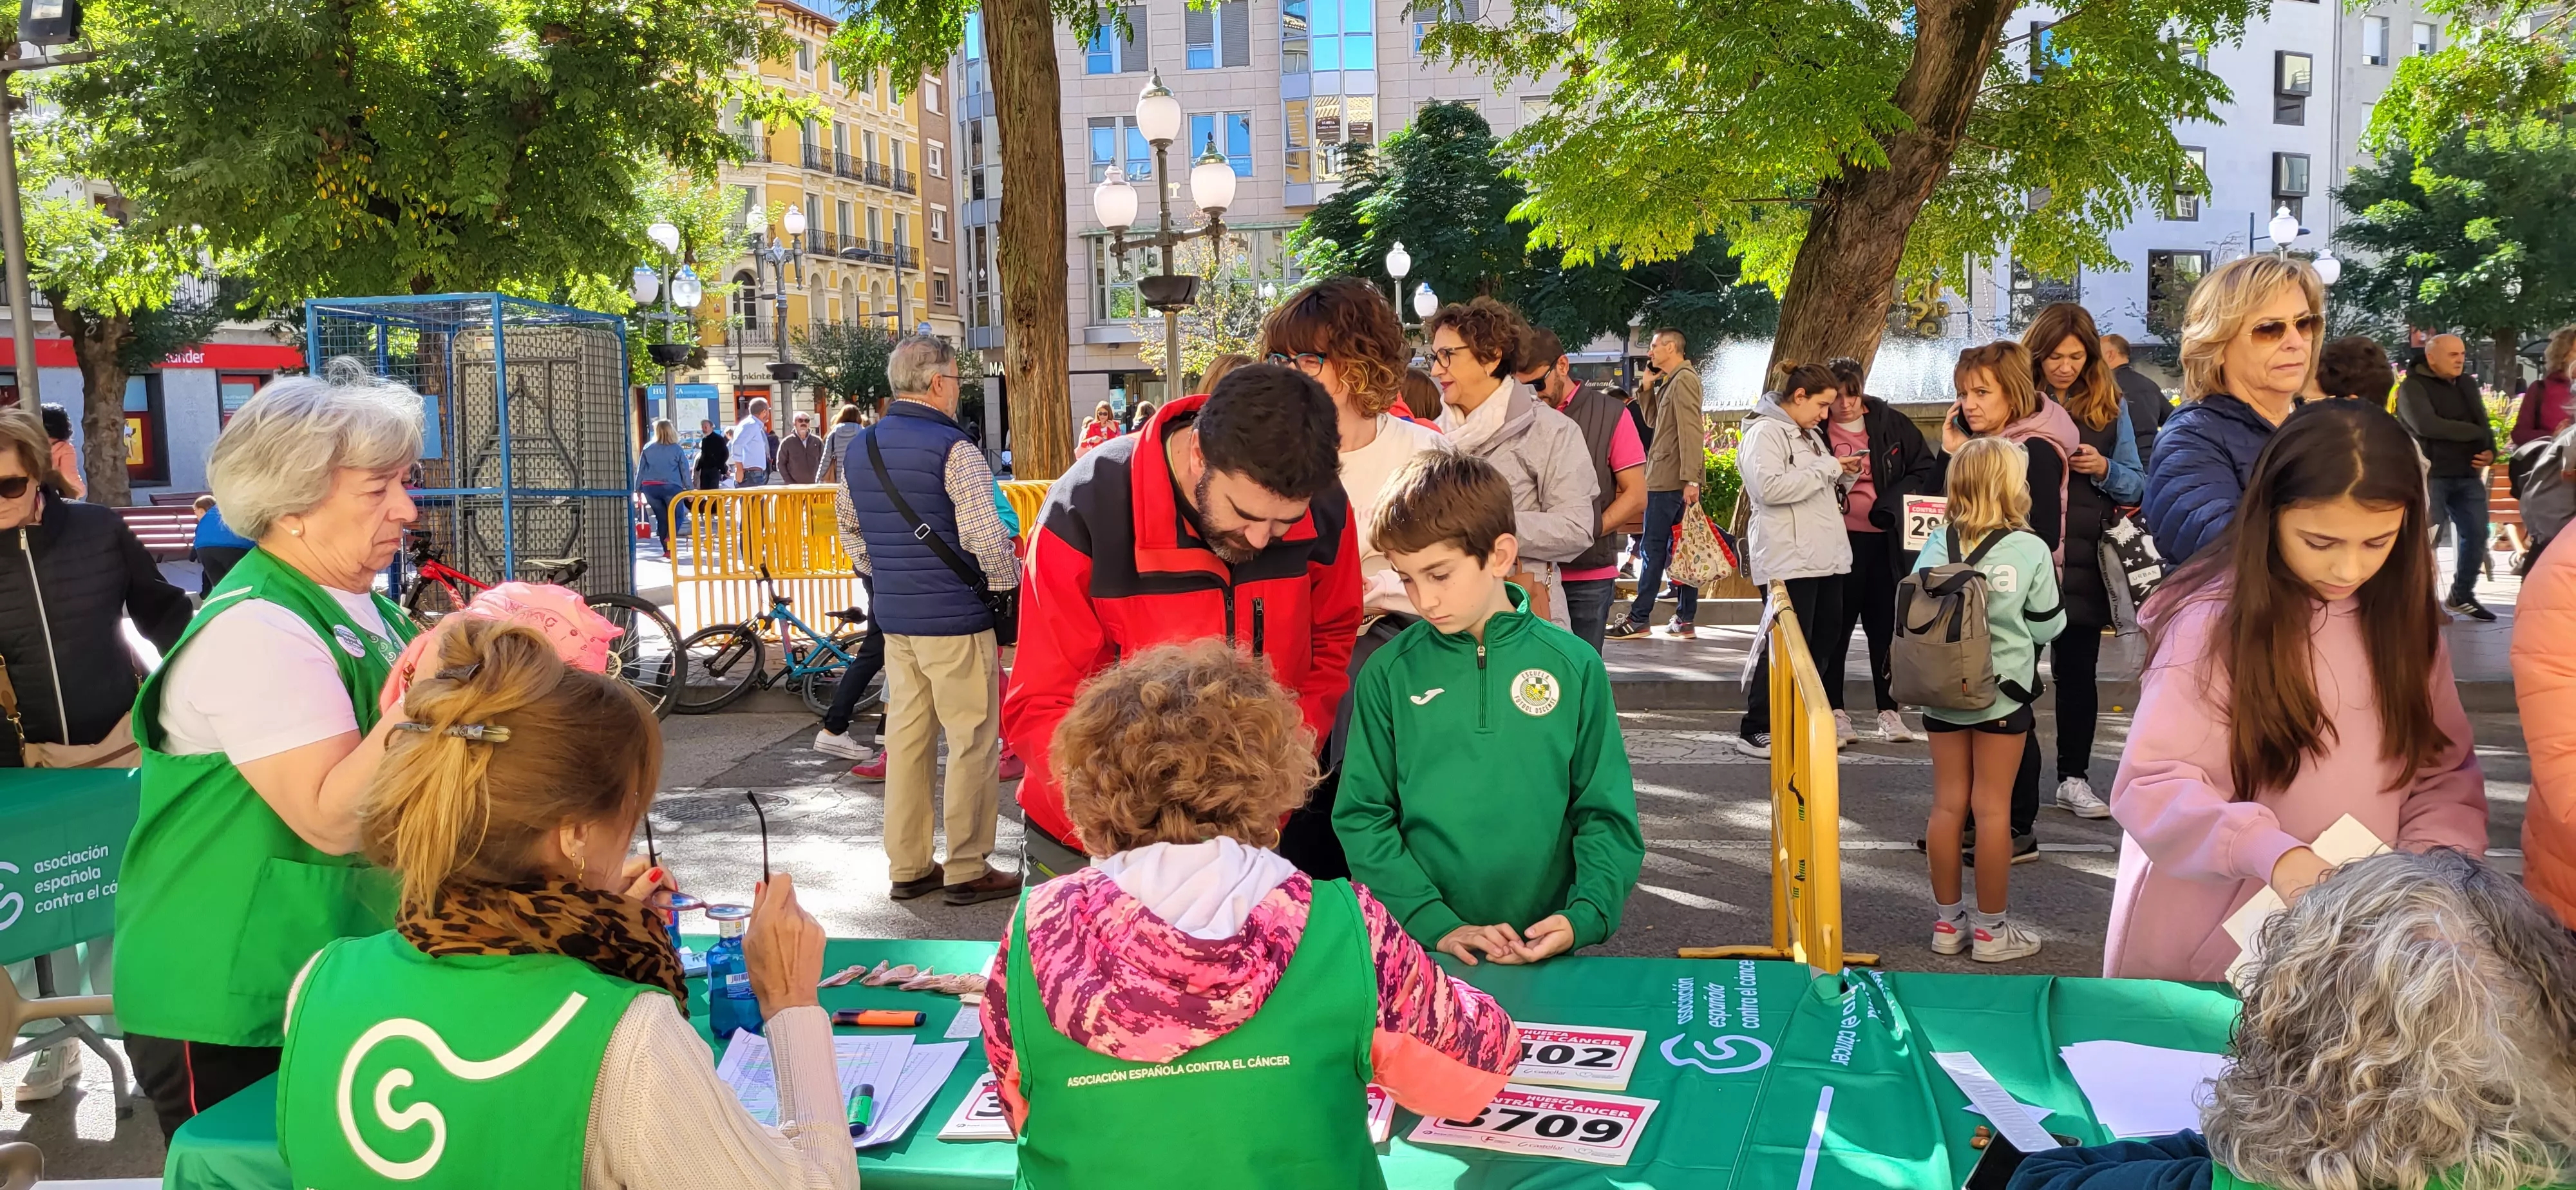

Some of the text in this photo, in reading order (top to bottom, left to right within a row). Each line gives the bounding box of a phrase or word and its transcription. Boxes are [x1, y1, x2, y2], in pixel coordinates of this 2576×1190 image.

[2132, 571, 2157, 581] URBAN
[1521, 670, 1549, 680] ESCUELA
[1535, 697, 1557, 714] OSCENSE
[34, 844, 109, 873] asociación
[34, 866, 101, 893] española
[35, 891, 84, 913] contra
[87, 883, 99, 900] el
[1734, 987, 1757, 996] el
[1671, 977, 1694, 1025] asociación
[1703, 981, 1739, 1028] española
[1736, 997, 1760, 1028] contra
[1841, 1015, 1861, 1028] el
[1557, 1034, 1621, 1046] CÁNCER
[1830, 1030, 1861, 1066] cáncer
[1067, 1055, 1291, 1087] ASOCIACIÓN ESPAÑOLA CONTRA EL CÁNCER
[1526, 1095, 1575, 1106] HUESCA
[1560, 1103, 1630, 1118] CÁNCER
[1528, 1143, 1565, 1151] castellar
